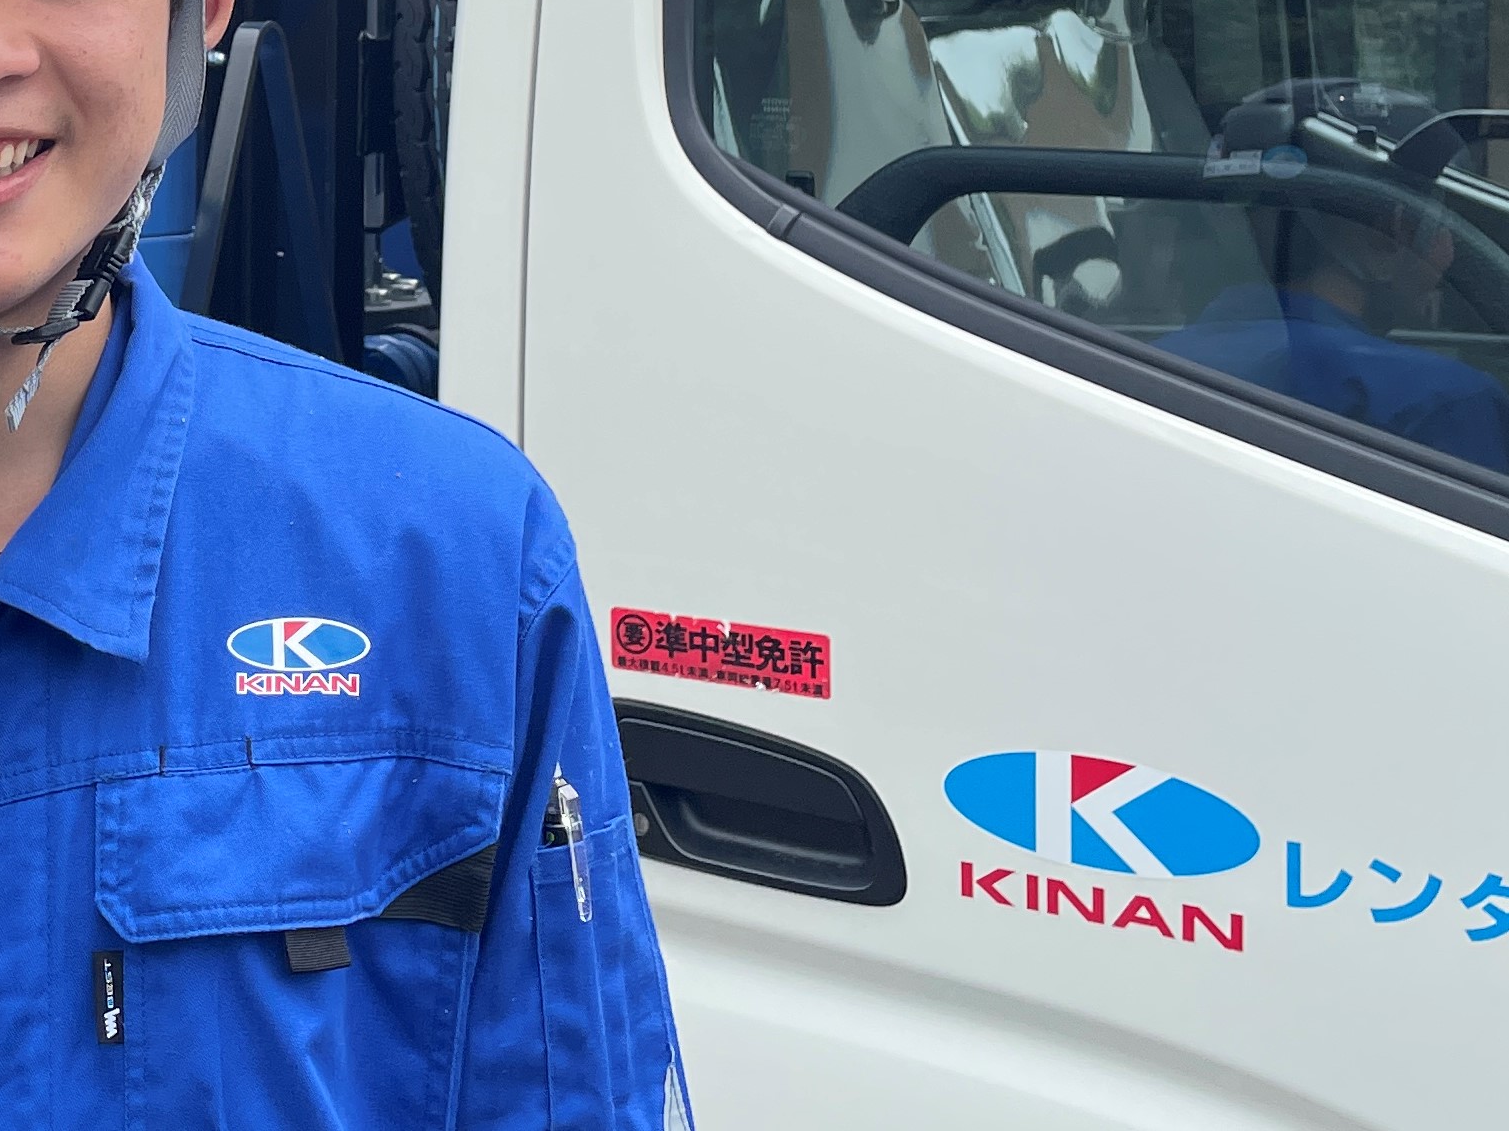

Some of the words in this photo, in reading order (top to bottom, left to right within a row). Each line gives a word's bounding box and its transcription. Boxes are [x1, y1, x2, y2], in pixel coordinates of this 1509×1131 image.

[237, 673, 359, 695] KINAN
[960, 861, 1244, 953] KINAN
[1286, 841, 1509, 942] レンタ
